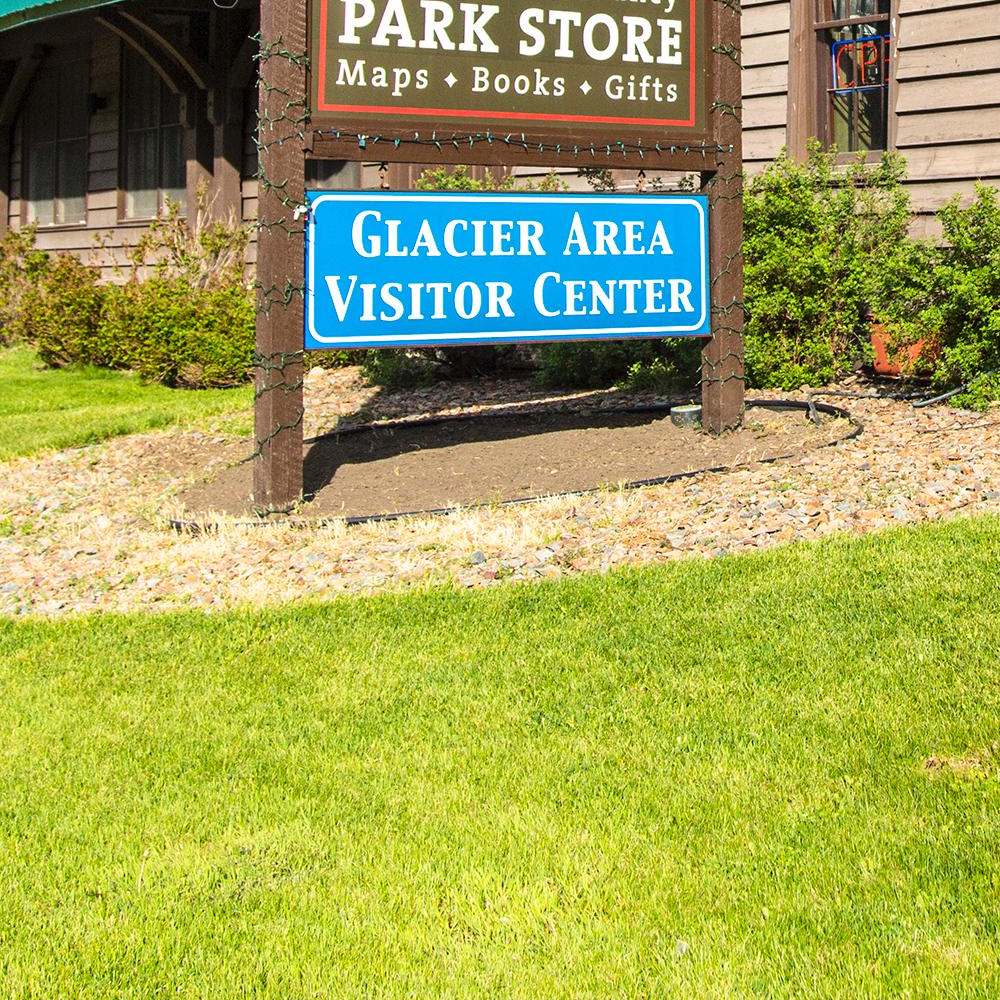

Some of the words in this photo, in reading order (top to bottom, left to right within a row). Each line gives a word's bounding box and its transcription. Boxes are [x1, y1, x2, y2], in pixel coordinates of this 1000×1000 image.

[519, 7, 683, 65] STORE
[335, 58, 429, 96] Maps
[472, 66, 566, 97] Books
[605, 74, 678, 103] Gifts
[351, 210, 546, 258] GLACIER
[562, 211, 674, 256] AREA
[324, 274, 515, 322] VISITOR
[533, 271, 695, 317] CENTER
